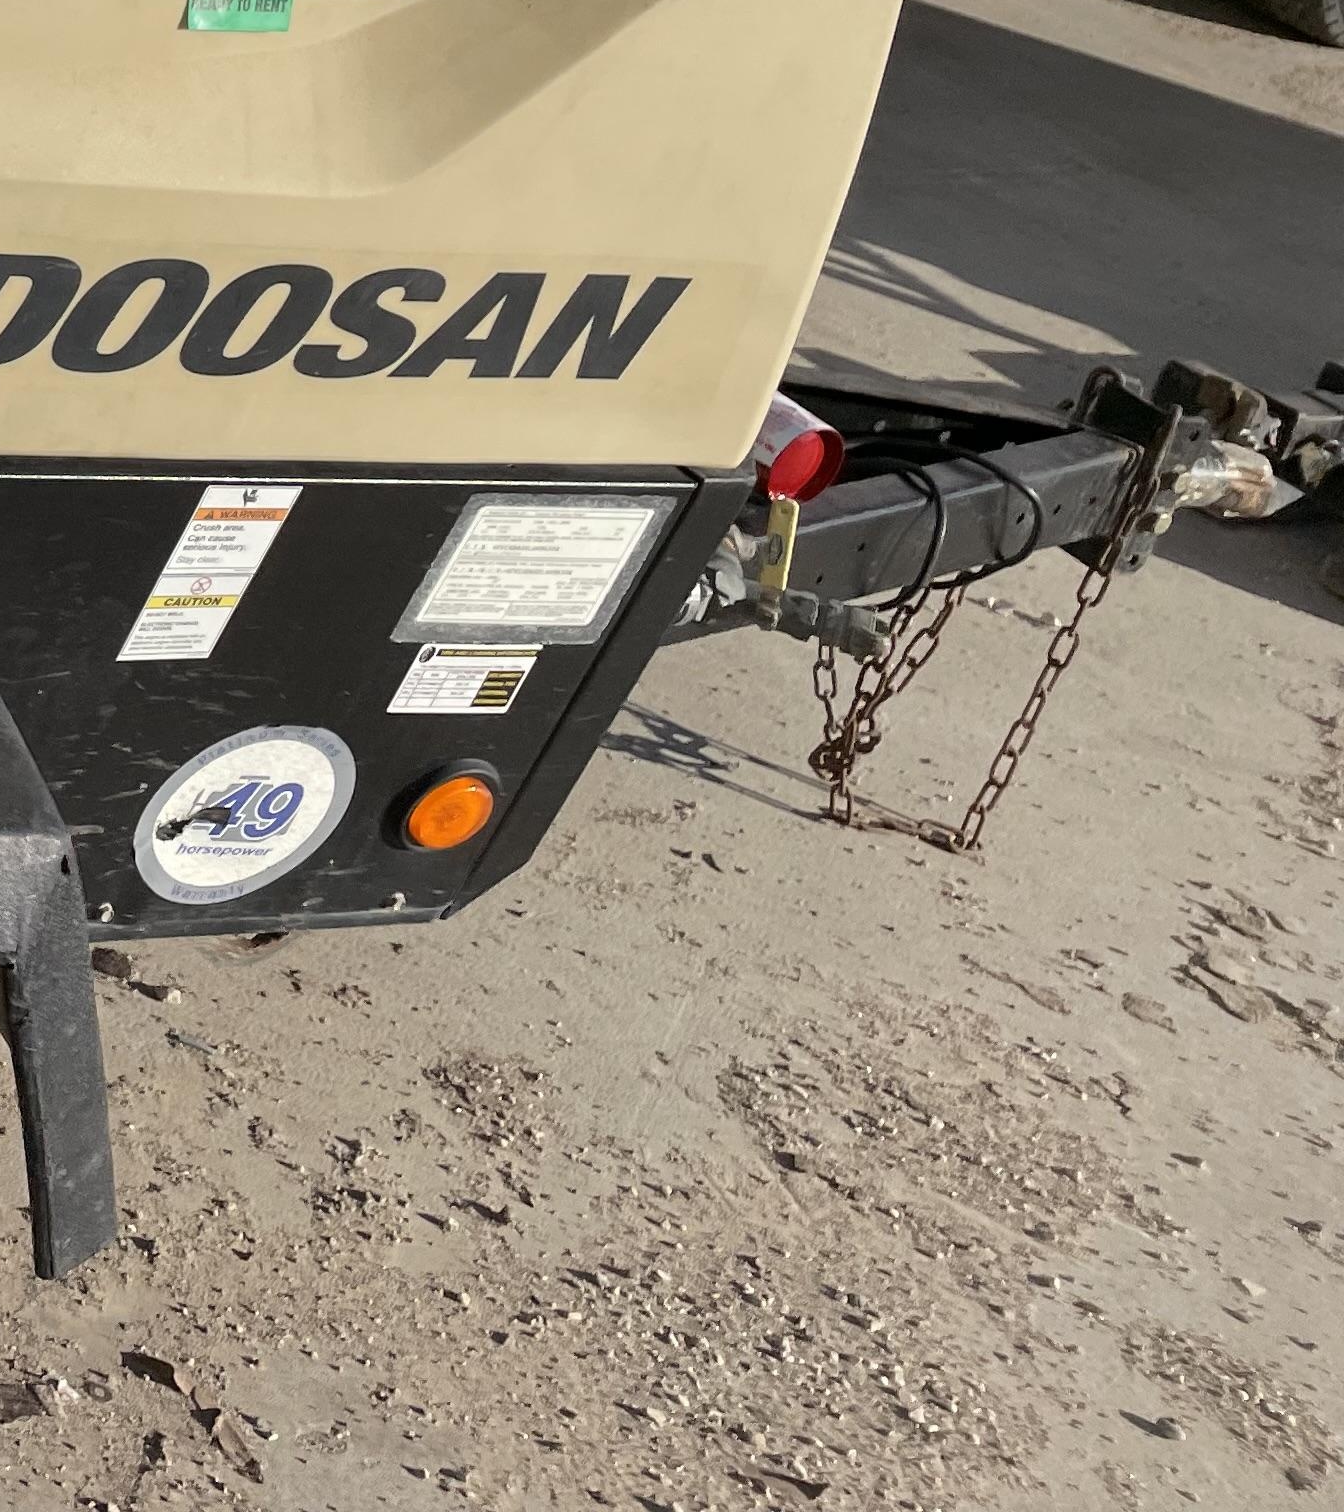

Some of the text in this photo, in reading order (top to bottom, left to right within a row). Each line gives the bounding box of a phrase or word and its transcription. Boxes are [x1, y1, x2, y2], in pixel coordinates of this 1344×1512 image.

[220, 510, 277, 520] WARNING
[163, 597, 223, 607] CAUTION
[209, 781, 305, 839] 49
[175, 843, 273, 857] horsepower
